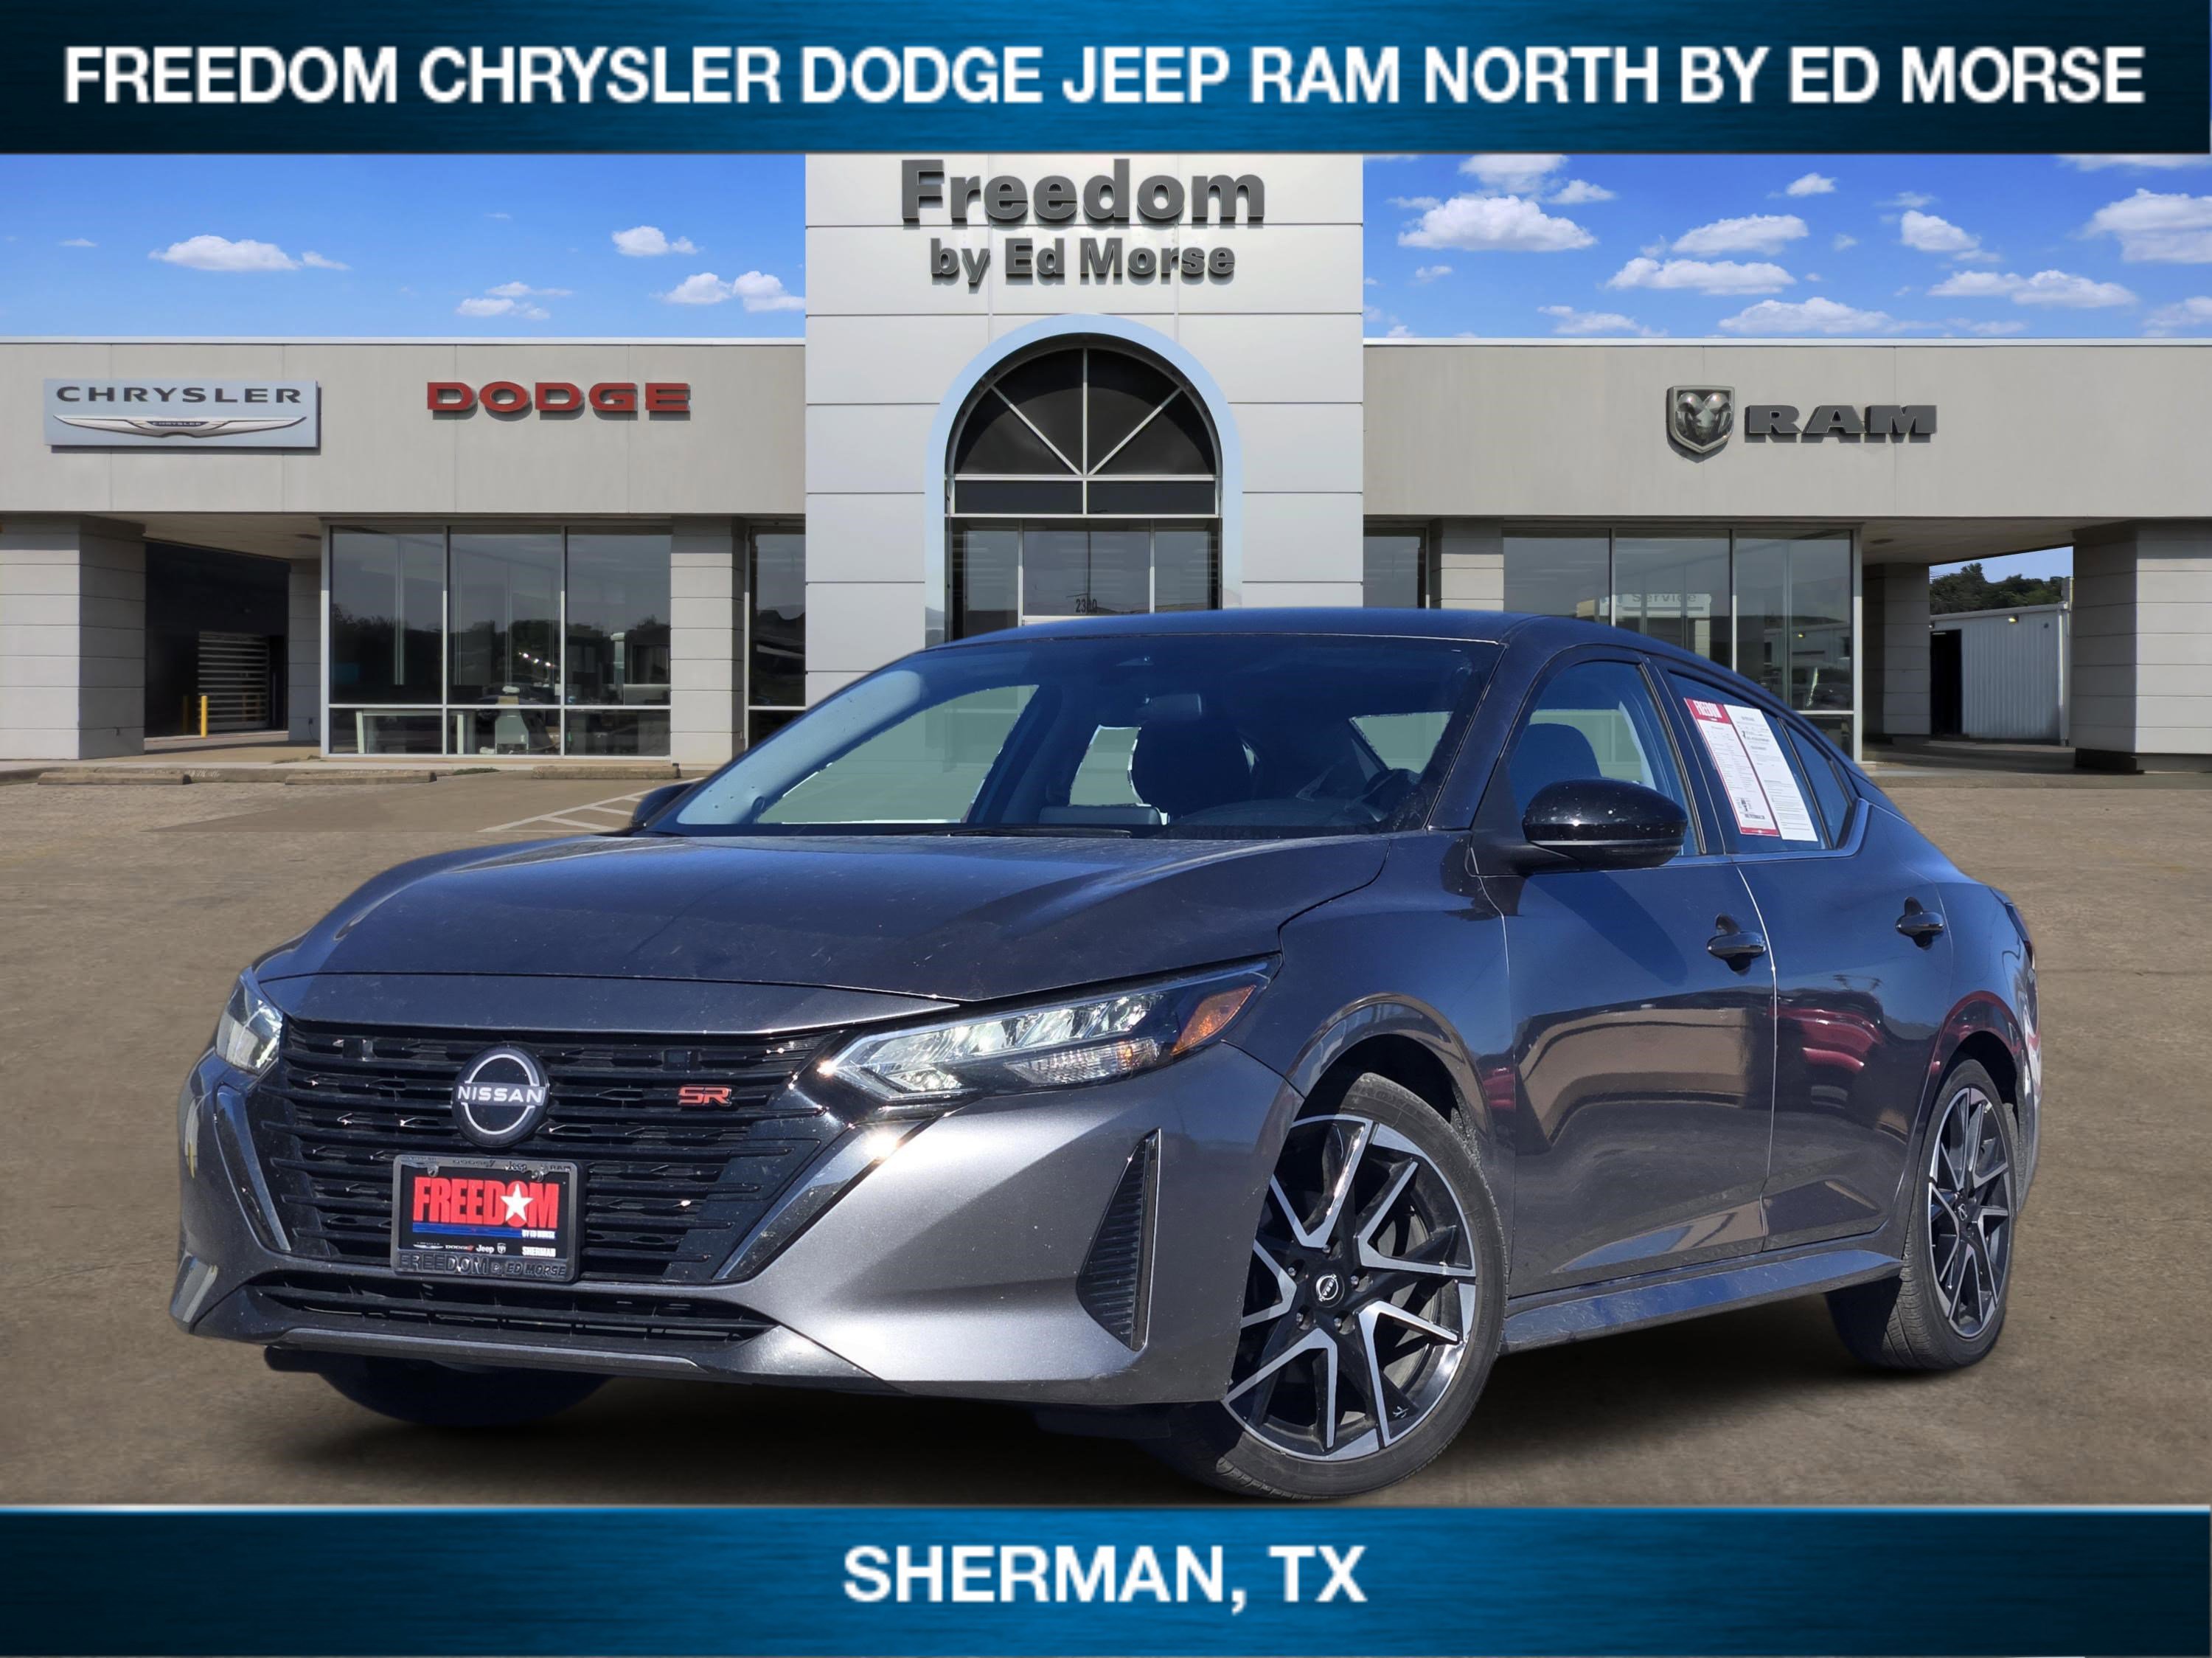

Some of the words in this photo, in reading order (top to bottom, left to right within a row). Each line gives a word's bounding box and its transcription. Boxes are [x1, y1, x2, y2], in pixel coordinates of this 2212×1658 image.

[901, 159, 1265, 223] Freedom
[931, 237, 990, 288] by
[1005, 237, 1065, 279] Ed
[1079, 237, 1236, 279] Morse
[56, 386, 302, 404] CHRYSLER
[427, 381, 690, 412] DODGE
[1745, 404, 1938, 434] RAM
[457, 1085, 543, 1104] NISSAN
[678, 1086, 731, 1106] SR
[476, 1244, 495, 1254] Jeep
[400, 1253, 489, 1274] FREEDOM
[507, 1262, 523, 1274] ED
[524, 1262, 567, 1277] MORSE
